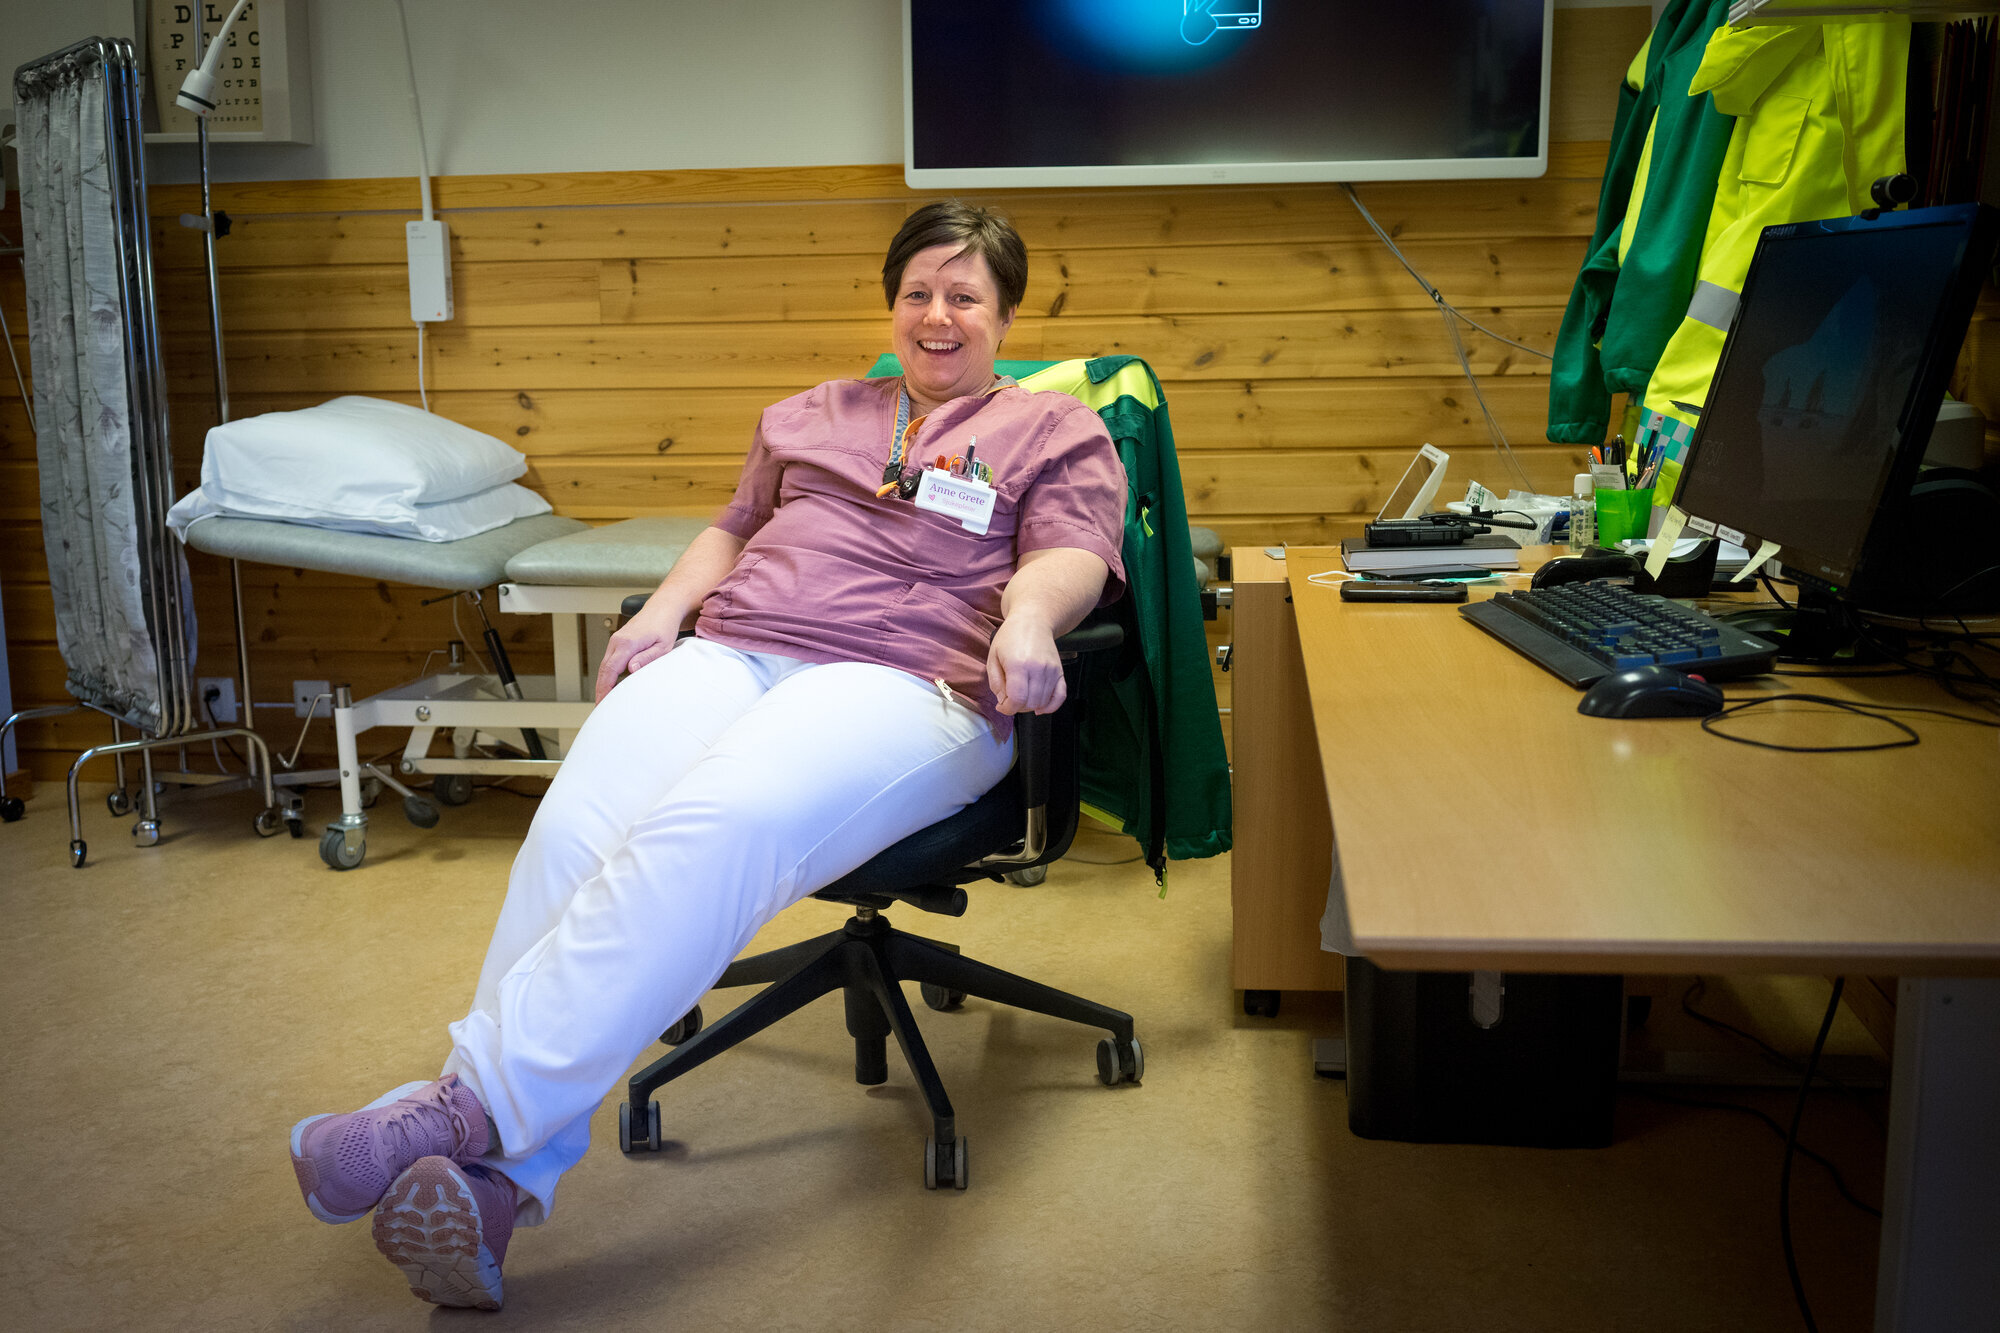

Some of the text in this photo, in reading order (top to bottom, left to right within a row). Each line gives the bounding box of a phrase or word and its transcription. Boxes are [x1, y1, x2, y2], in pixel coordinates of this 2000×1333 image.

[174, 5, 191, 23] D
[204, 4, 222, 23] L
[170, 34, 184, 49] P
[176, 59, 186, 70] F
[231, 57, 243, 70] D
[929, 483, 985, 506] Anne Grete
